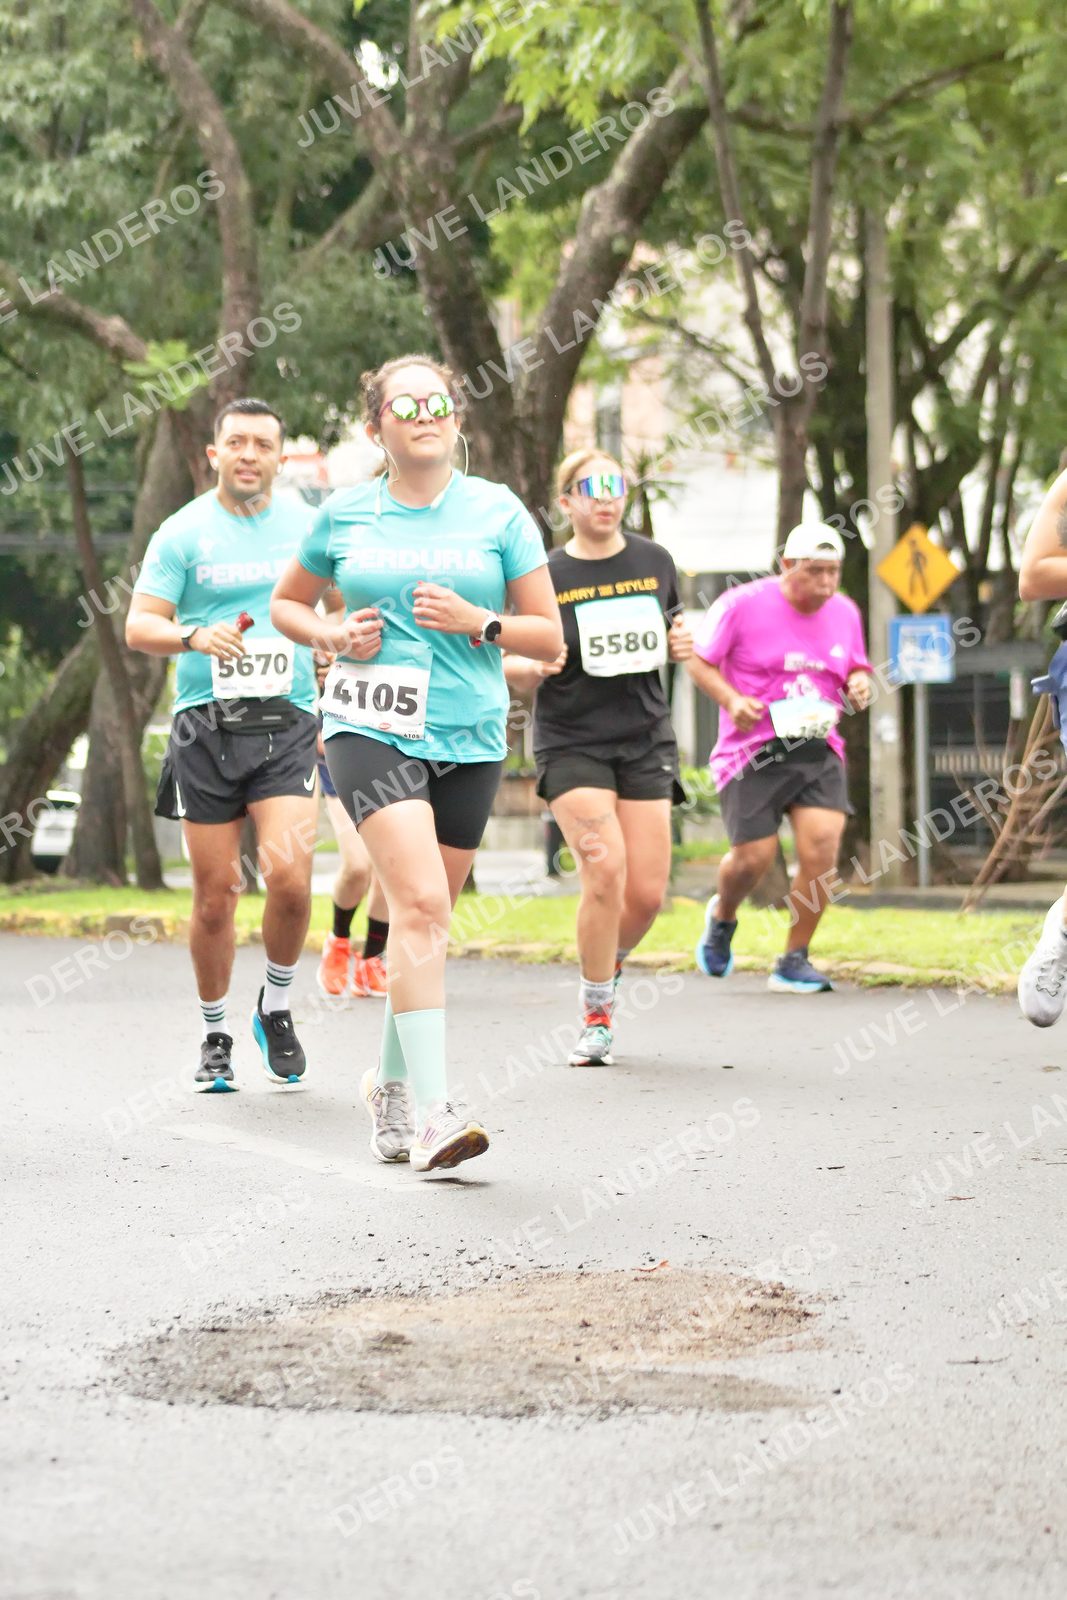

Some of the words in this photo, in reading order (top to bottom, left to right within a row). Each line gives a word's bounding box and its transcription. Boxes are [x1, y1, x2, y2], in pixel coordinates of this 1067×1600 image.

[196, 559, 288, 584] PERDU
[557, 586, 596, 604] HARRY
[615, 577, 658, 594] STYLES
[589, 631, 658, 656] 5580
[218, 653, 288, 678] 5670
[333, 679, 418, 716] 4105
